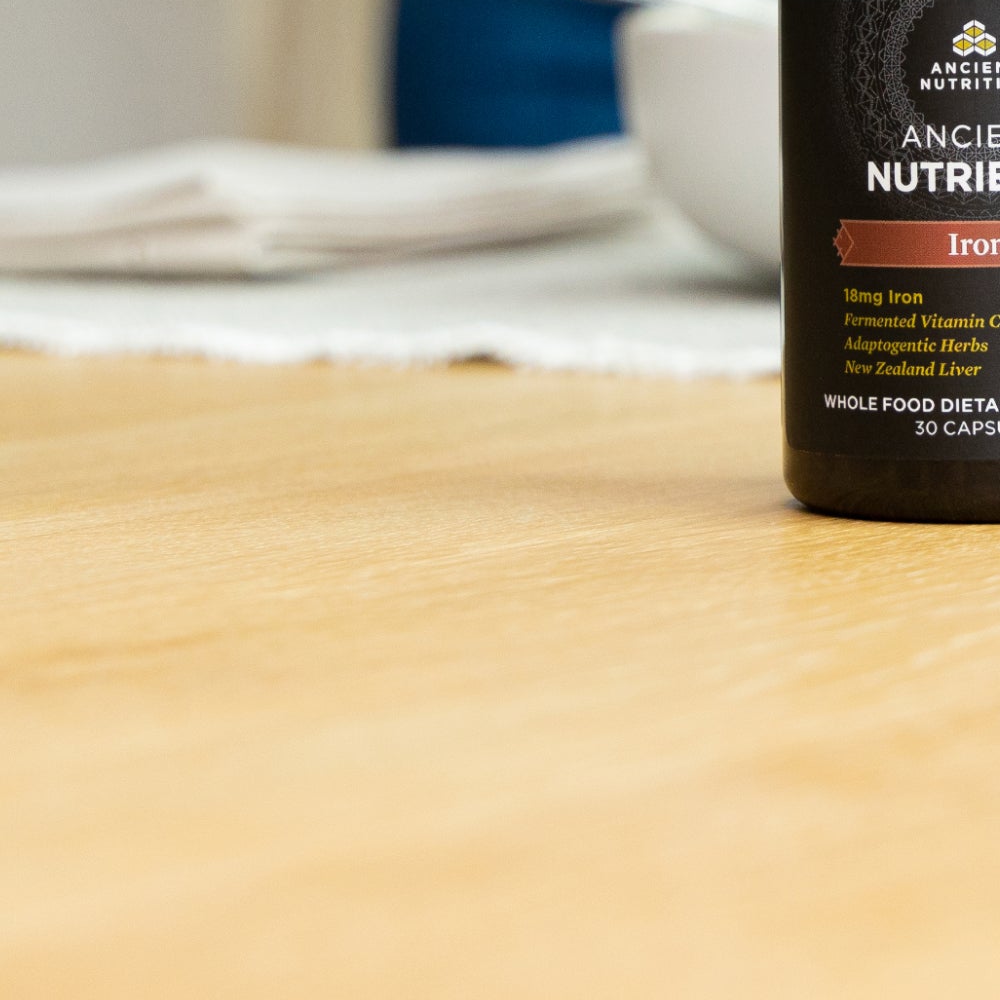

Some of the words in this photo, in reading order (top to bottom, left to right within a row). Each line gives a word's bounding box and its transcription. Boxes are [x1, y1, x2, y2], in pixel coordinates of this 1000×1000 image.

[844, 288, 883, 305] 18mg
[890, 290, 922, 304] Iron
[844, 313, 917, 328] Fermented
[922, 314, 984, 328] Vitamin
[989, 315, 1000, 328] C
[844, 336, 937, 354] Adaptogentic
[941, 338, 988, 352] Herbs
[844, 360, 873, 374] New
[876, 361, 935, 376] Zealand
[939, 362, 982, 376] Liver
[825, 395, 877, 410] WHOLE
[883, 398, 935, 412] FOOD
[916, 421, 937, 435] 30
